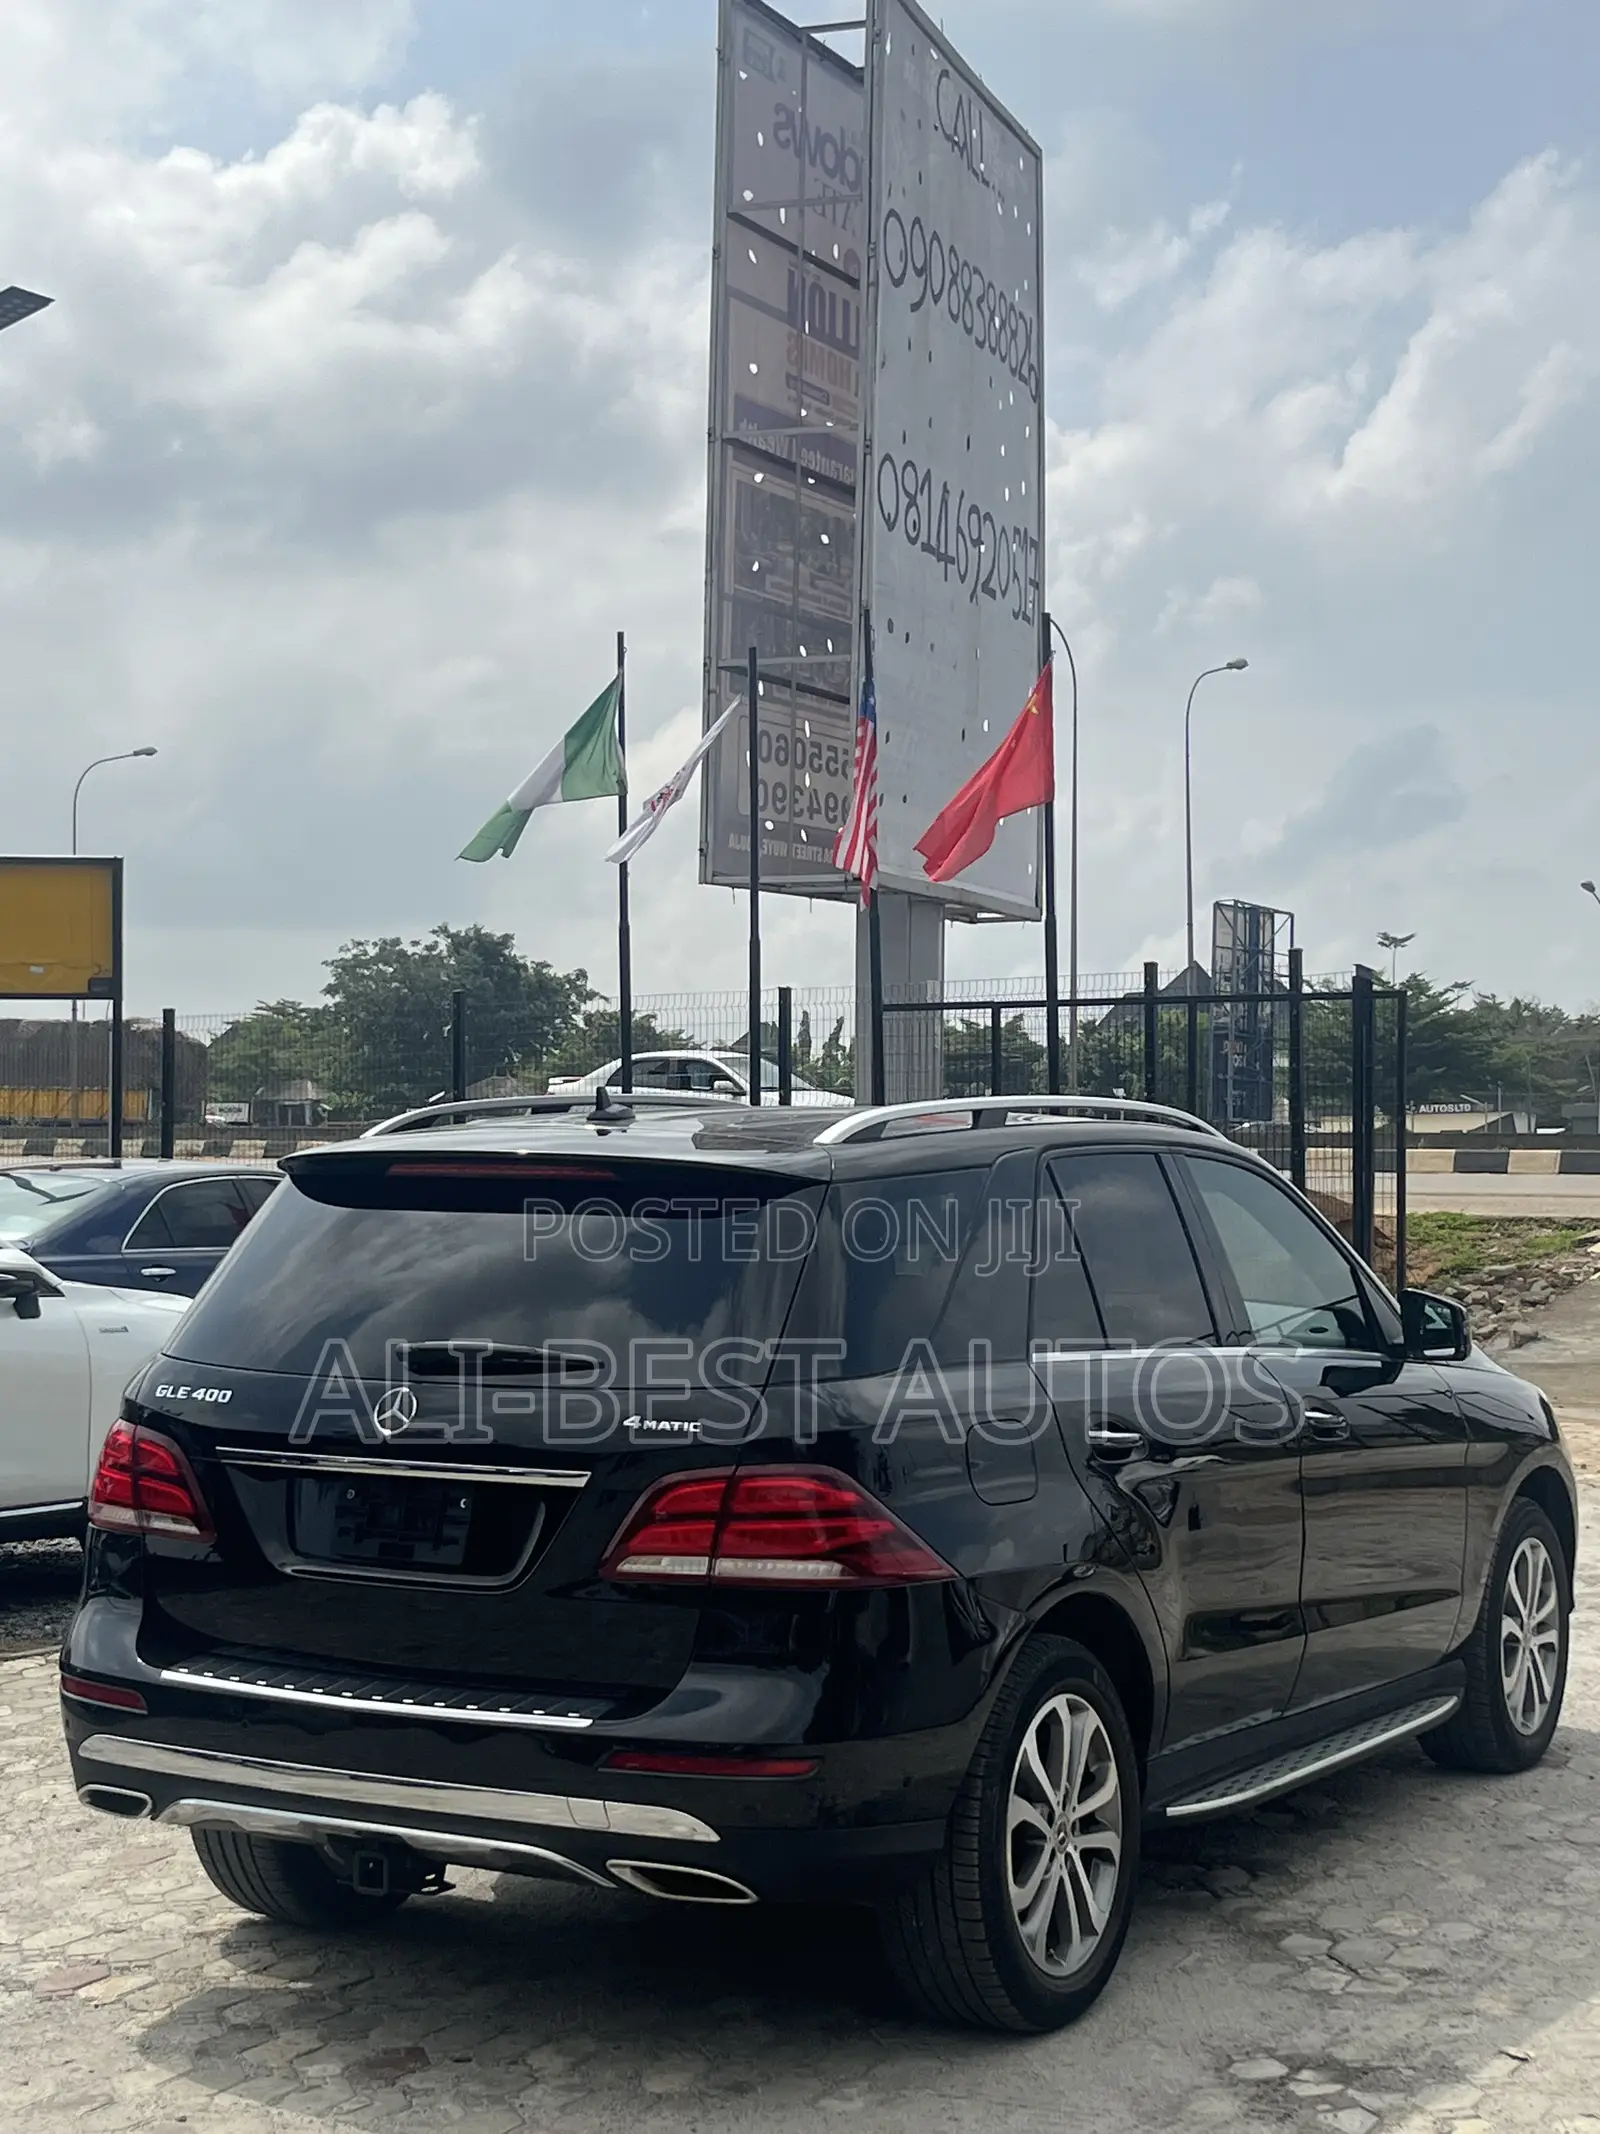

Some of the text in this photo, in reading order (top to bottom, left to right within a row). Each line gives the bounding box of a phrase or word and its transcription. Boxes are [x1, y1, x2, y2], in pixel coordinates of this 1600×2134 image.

[155, 1384, 233, 1403] GLE 400
[622, 1415, 702, 1433] 4MATIC
